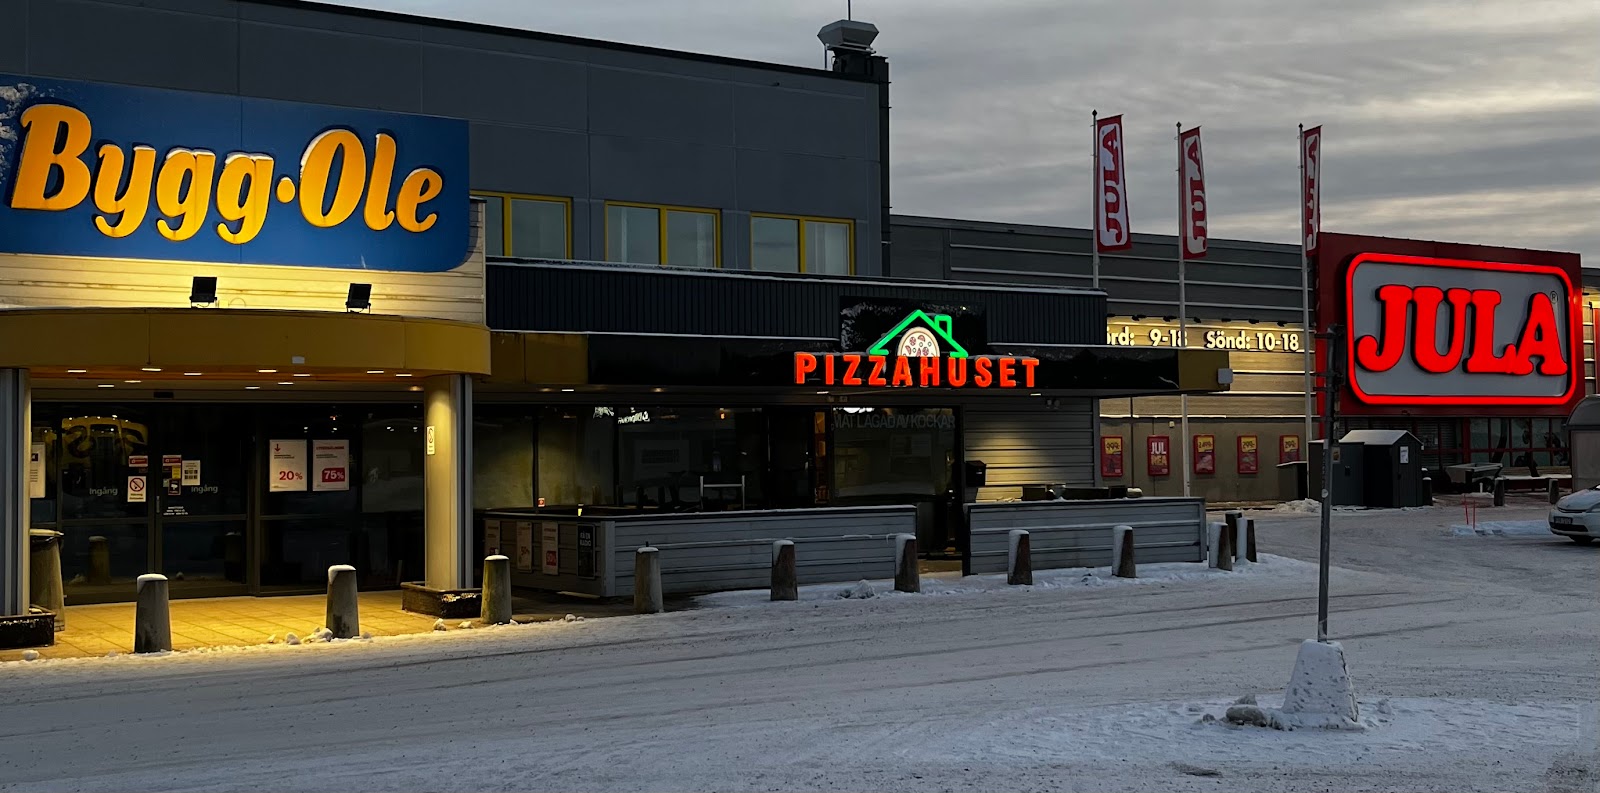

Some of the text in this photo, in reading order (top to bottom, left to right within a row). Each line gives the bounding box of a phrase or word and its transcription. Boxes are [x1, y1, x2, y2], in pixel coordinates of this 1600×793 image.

[1102, 125, 1123, 244] JULA
[1187, 138, 1207, 250] JULA
[1107, 326, 1135, 346] rd:
[1205, 330, 1251, 349] Sönd:
[1256, 332, 1300, 351] 10-18
[1355, 284, 1568, 376] JULA
[794, 352, 1040, 387] PIZZAHUSET
[1150, 442, 1167, 454] JUL
[279, 470, 303, 481] 20%
[323, 469, 345, 480] 75%
[89, 486, 118, 497] Ingång
